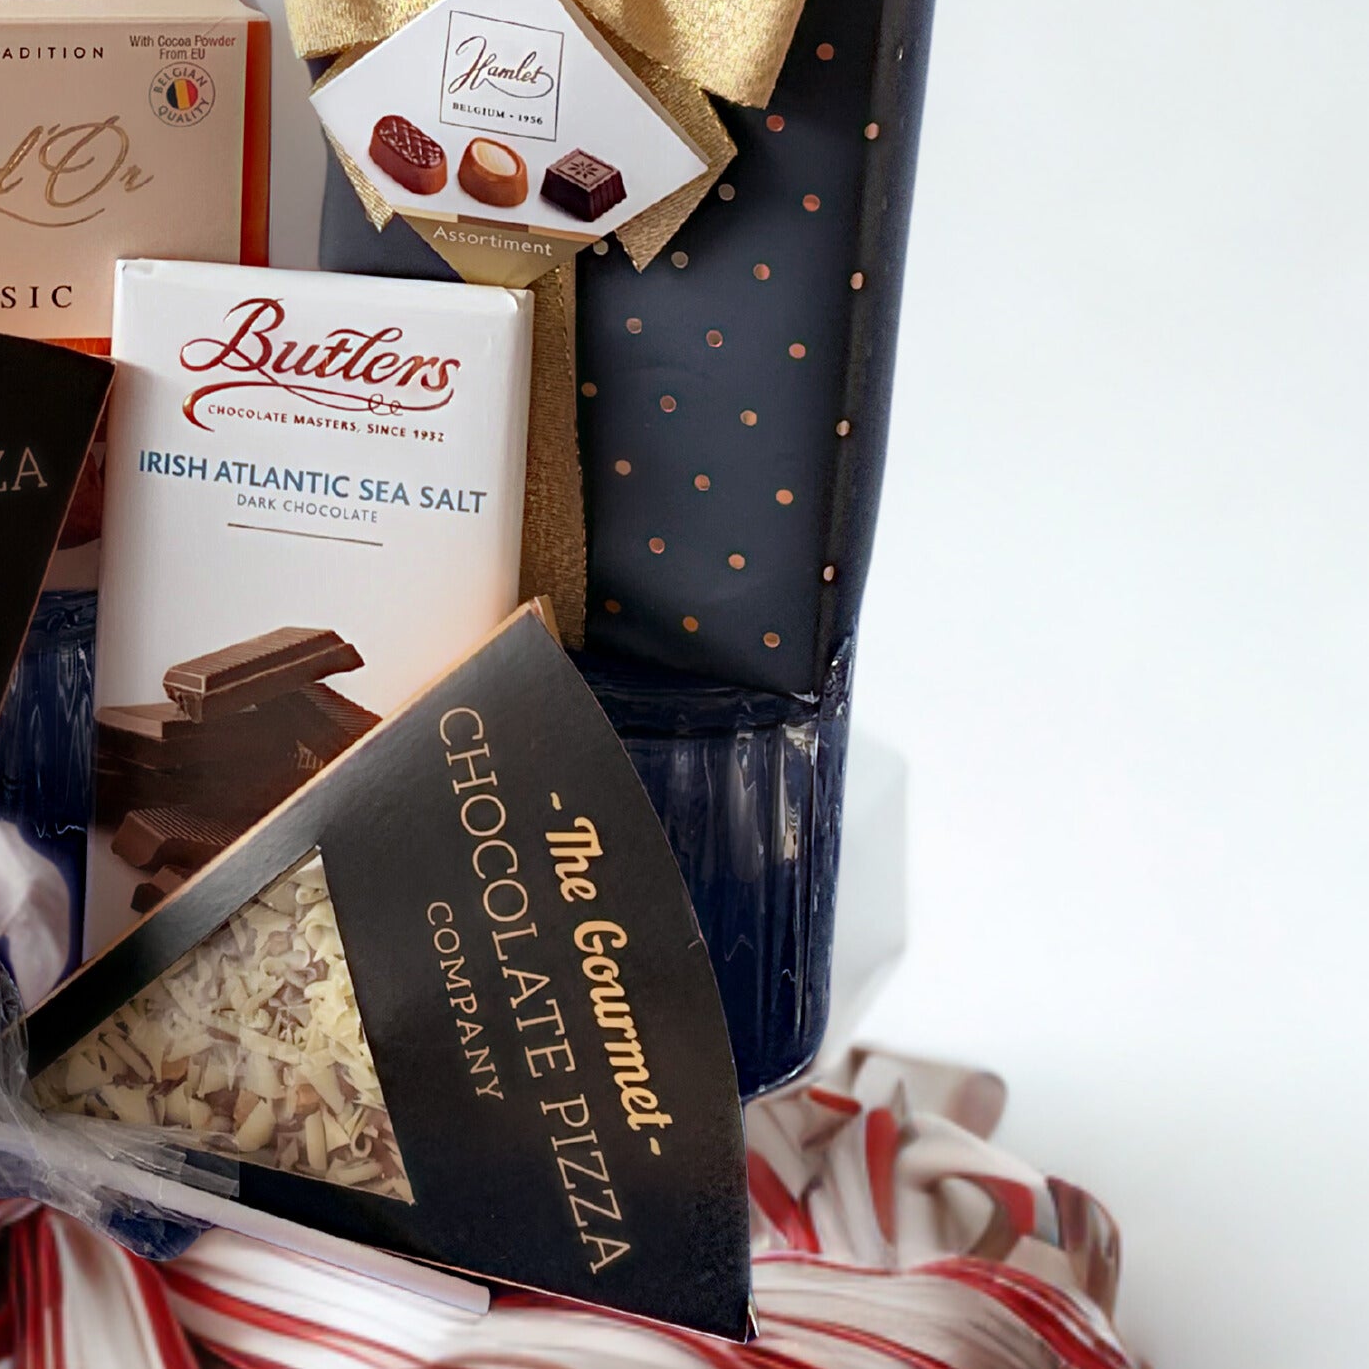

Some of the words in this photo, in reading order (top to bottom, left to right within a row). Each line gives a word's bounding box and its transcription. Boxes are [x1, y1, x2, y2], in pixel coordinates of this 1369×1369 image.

[130, 35, 154, 47] With
[157, 35, 191, 47] Cocoa
[195, 34, 236, 47] Powder
[159, 48, 187, 60] From
[191, 48, 206, 60] EU
[153, 67, 208, 94] BELGIAN
[448, 36, 553, 98] Hamlet
[158, 98, 210, 123] QUALITY
[452, 102, 505, 119] BELGIUM
[518, 114, 543, 125] 1956
[433, 226, 553, 257] Assortiment
[180, 298, 461, 401] Butlers
[208, 404, 287, 423] CHOCOLATE
[293, 413, 360, 433] MASTERS,
[367, 423, 406, 437] SINCE
[413, 430, 444, 443] 1932
[139, 450, 207, 480] IRISH
[214, 462, 350, 498] ATLANTIC
[359, 479, 408, 506] SEA
[419, 486, 487, 514] SALT
[237, 493, 276, 511] DARK
[283, 500, 378, 523] CHOCOLATE
[426, 900, 505, 1103] COMPANY
[439, 706, 577, 1079] CHOCOLATE
[540, 1095, 631, 1276] PIZZA
